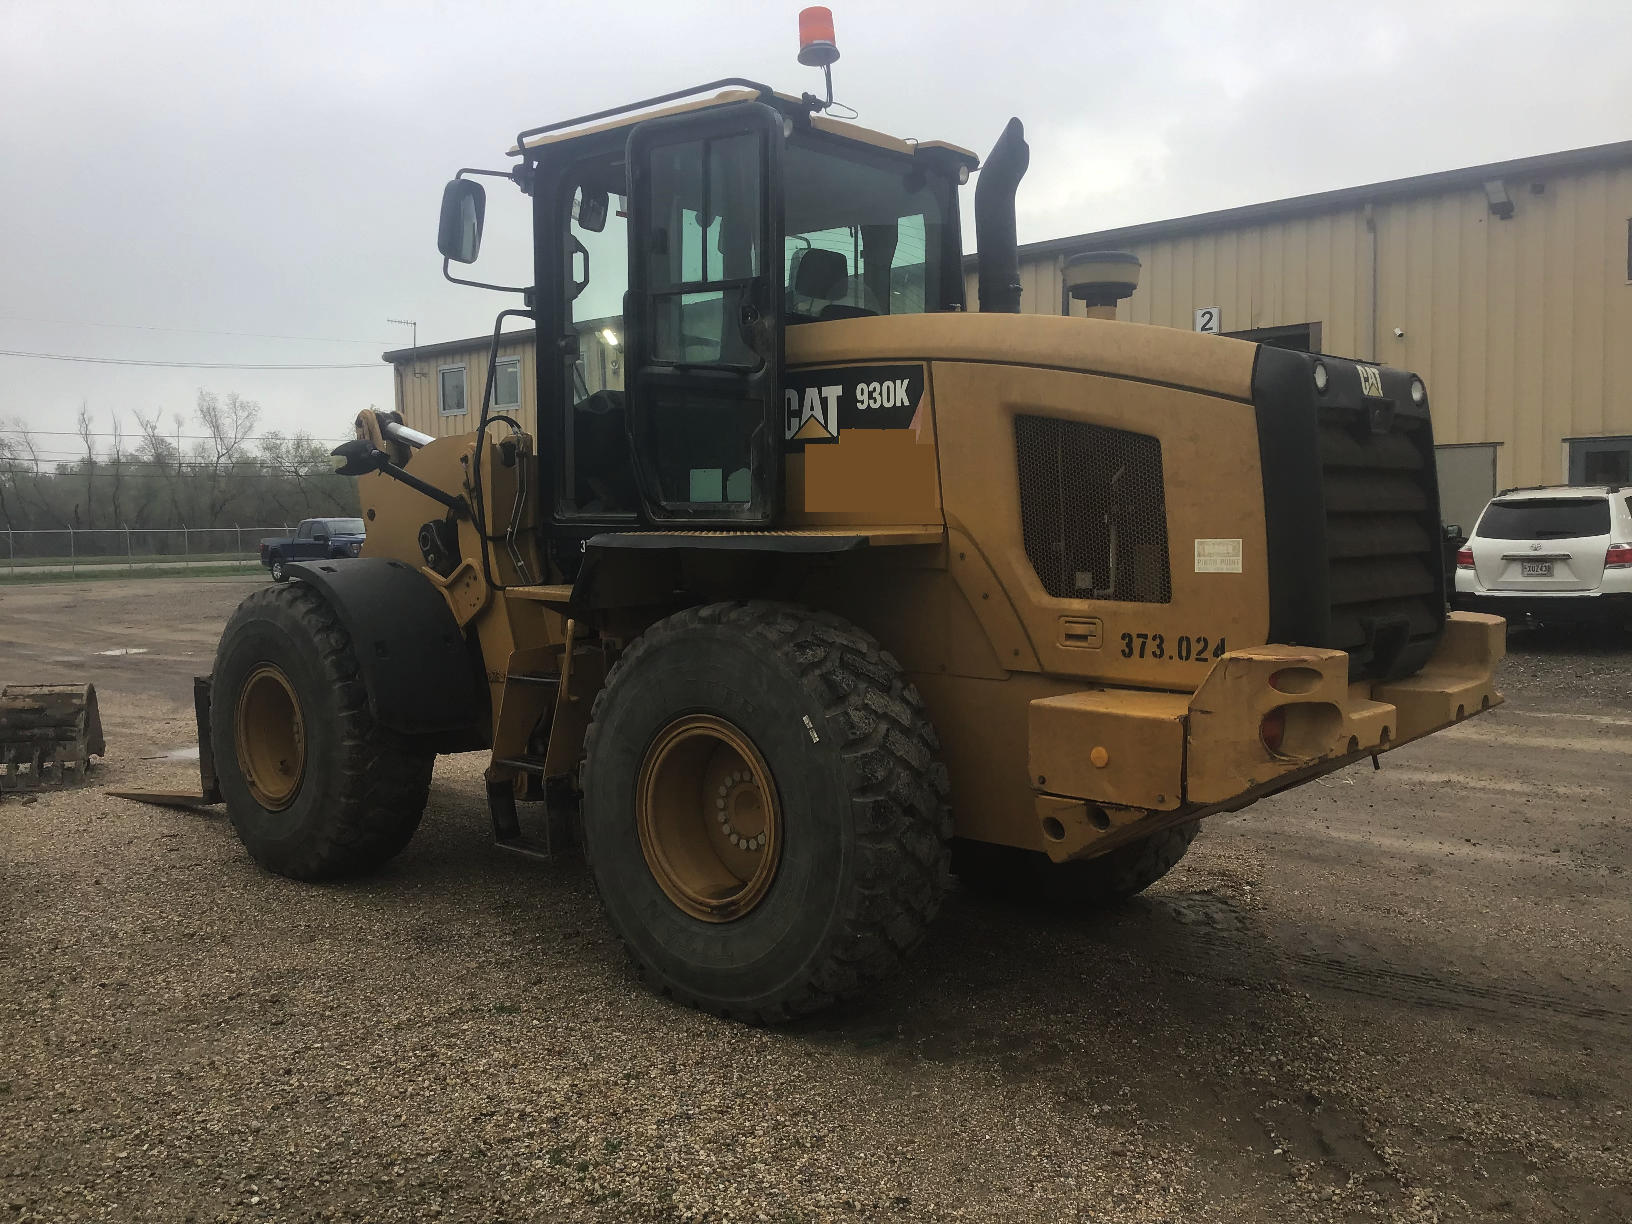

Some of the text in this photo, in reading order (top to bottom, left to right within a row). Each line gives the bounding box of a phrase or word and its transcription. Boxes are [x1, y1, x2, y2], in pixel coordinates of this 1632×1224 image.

[1200, 311, 1214, 332] 2
[1355, 365, 1384, 397] CAT
[784, 378, 911, 440] CAT 930K
[1120, 632, 1226, 663] 373.024
